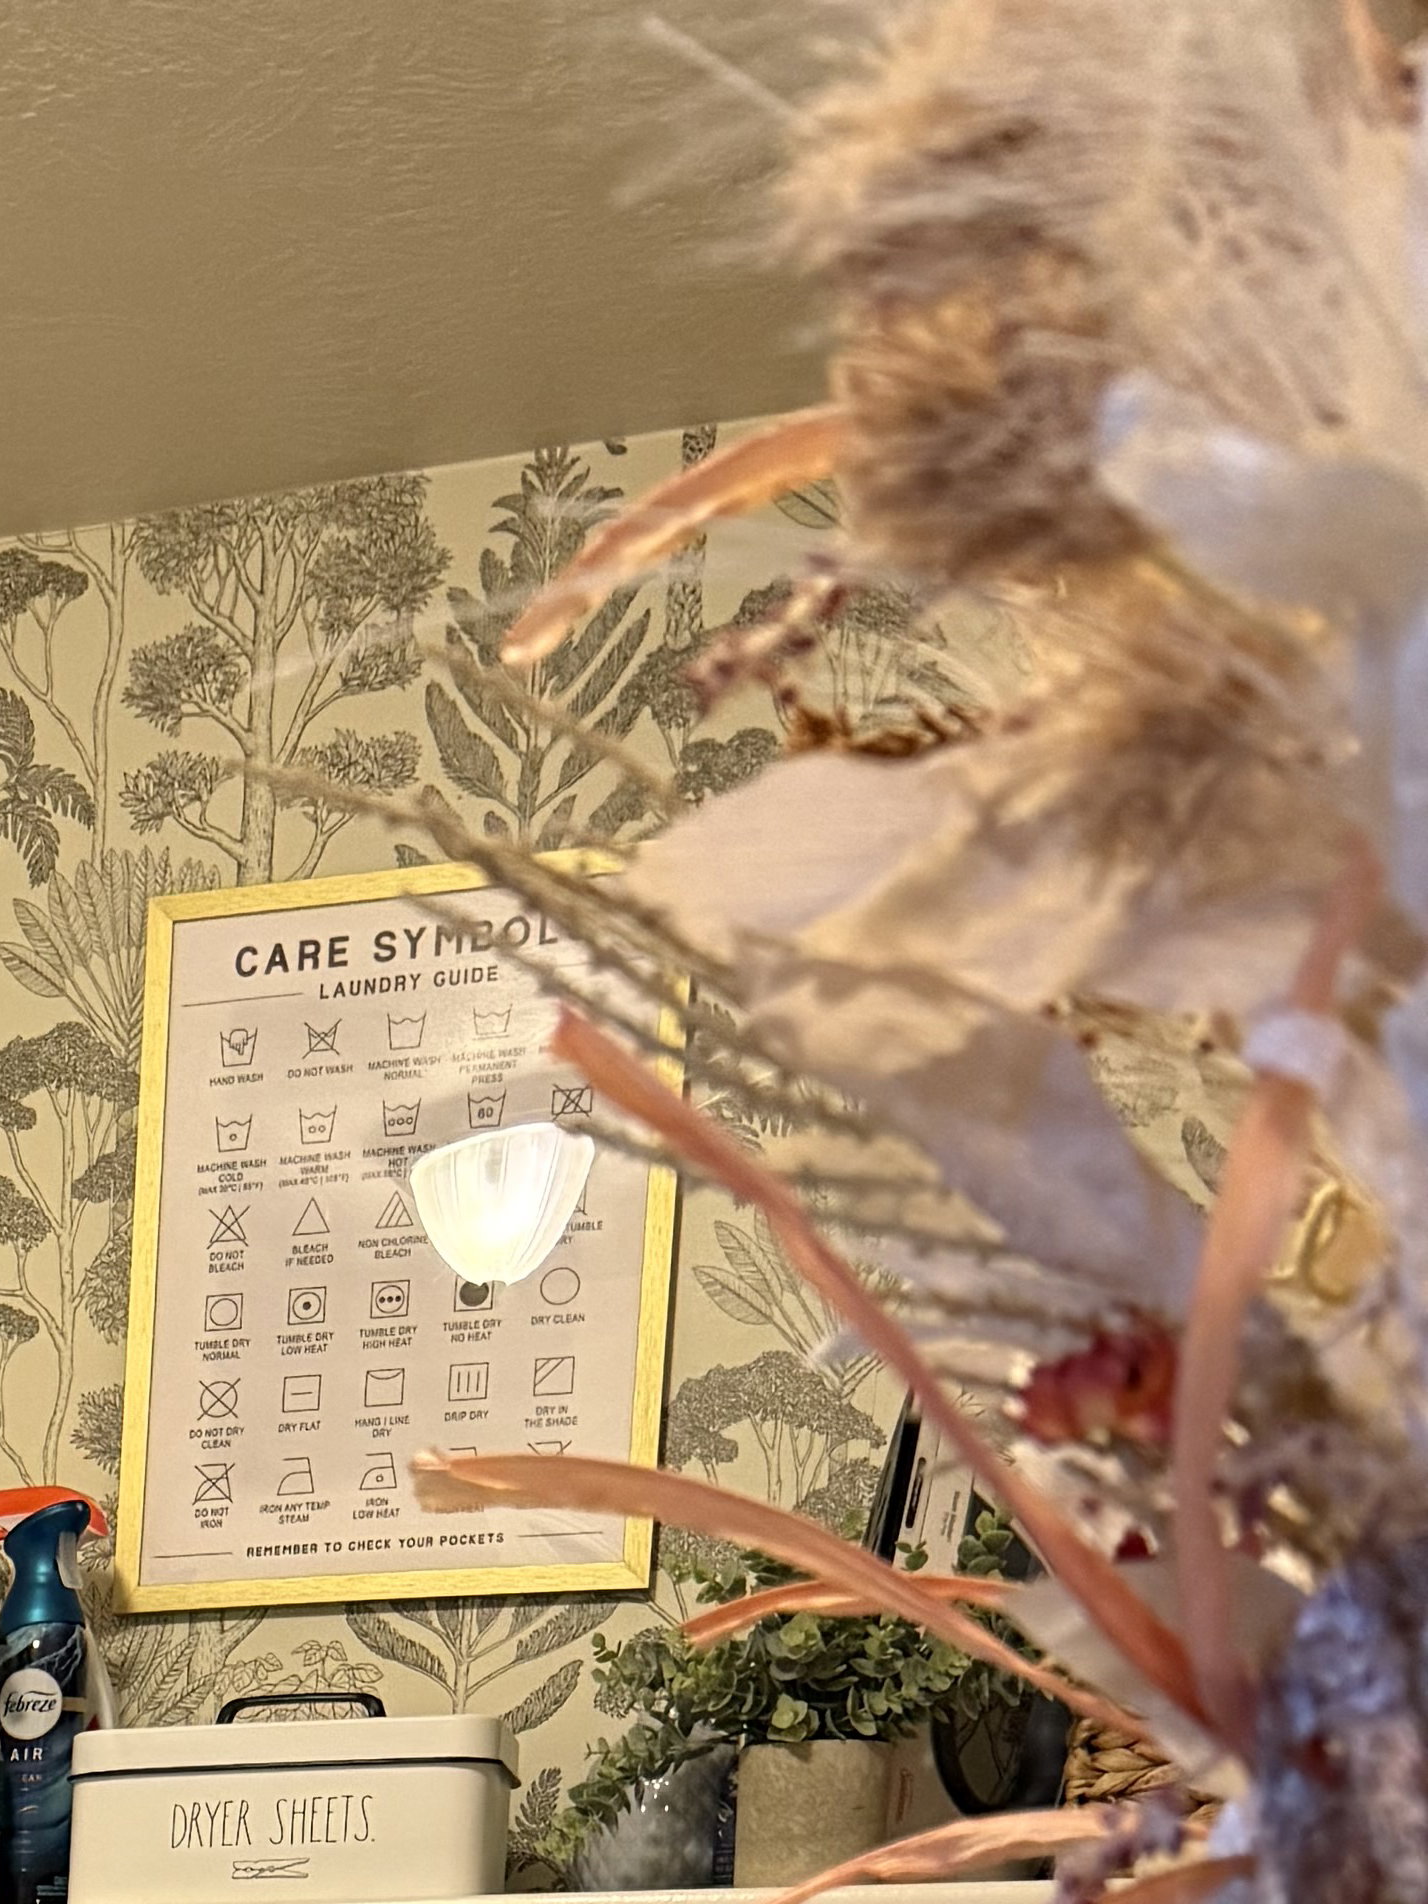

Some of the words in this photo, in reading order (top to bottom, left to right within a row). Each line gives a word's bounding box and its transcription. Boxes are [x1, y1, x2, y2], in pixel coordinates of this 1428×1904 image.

[235, 936, 350, 977] CARE
[373, 914, 559, 963] SYMBOL
[319, 973, 422, 1000] LAUNDRY
[433, 965, 500, 988] GUIDE
[498, 1047, 527, 1058] WASH
[368, 1058, 410, 1070] MACHINE
[412, 1055, 441, 1068] WASH
[458, 1060, 517, 1074] PERMANENT
[288, 1069, 302, 1078] DO
[304, 1068, 324, 1078] NOT
[326, 1065, 354, 1074] WASH
[383, 1069, 423, 1081] NORMAL
[209, 1076, 235, 1087] HAND
[238, 1073, 264, 1084] WASH
[472, 1074, 503, 1085] PRESS
[362, 1146, 406, 1158] MACHINE
[279, 1154, 321, 1166] MACHINE
[324, 1151, 352, 1161] WASH
[388, 1158, 408, 1168] HOT
[197, 1161, 238, 1174] MACHINE
[240, 1159, 267, 1169] WASH
[300, 1164, 329, 1174] WARM
[218, 1172, 244, 1183] COLD
[358, 1238, 380, 1248] NON
[381, 1236, 429, 1247] CHLORINE
[292, 1244, 329, 1254] BLEACH
[374, 1248, 412, 1260] BLEACH
[210, 1252, 221, 1262] DO
[224, 1250, 245, 1260] NOT
[285, 1257, 294, 1267] IF
[296, 1255, 334, 1266] NEEDED
[208, 1262, 244, 1274] BLEACH
[444, 1320, 480, 1332] TUMBLE
[482, 1319, 503, 1330] DRY
[530, 1316, 552, 1326] DRY
[554, 1314, 586, 1324] CLEAN
[277, 1334, 314, 1344] TUMBLE
[315, 1332, 334, 1342] DRY
[360, 1328, 396, 1338] TUMBLE
[398, 1326, 418, 1336] DRY
[451, 1334, 465, 1343] NO
[467, 1332, 492, 1342] HEAT
[194, 1340, 229, 1350] TUMBLE
[230, 1338, 251, 1349] DRY
[281, 1346, 302, 1356] LOW
[304, 1344, 328, 1354] HEAT
[362, 1340, 387, 1350] HIGH
[388, 1338, 413, 1348] HEAT
[202, 1350, 241, 1362] NORMAL
[444, 1412, 468, 1422] DRIP
[470, 1410, 490, 1420] DRY
[536, 1406, 556, 1416] DRY
[558, 1405, 568, 1415] IN
[278, 1423, 298, 1433] DRY
[300, 1421, 321, 1432] FLAT
[354, 1417, 381, 1428] HANG
[390, 1416, 410, 1426] LINE
[524, 1418, 543, 1428] THE
[546, 1416, 578, 1428] SHADE
[189, 1430, 203, 1439] DO
[205, 1428, 224, 1438] NOT
[226, 1426, 245, 1436] DRY
[372, 1428, 392, 1438] DRY
[201, 1440, 232, 1450] CLEAN
[260, 1504, 283, 1514] IRON
[284, 1502, 303, 1512] ANY
[306, 1500, 331, 1510] TEMP
[366, 1498, 389, 1507] IRON
[194, 1508, 206, 1518] DO
[208, 1508, 229, 1517] NOT
[278, 1514, 310, 1524] STEAM
[353, 1510, 374, 1520] LOW
[376, 1508, 400, 1518] HEAT
[200, 1518, 223, 1528] IRON
[246, 1544, 318, 1558] REMEMBER
[325, 1542, 342, 1552] TO
[348, 1538, 392, 1551] CHECK
[398, 1536, 434, 1548] YOUR
[440, 1532, 505, 1546] POCKETS
[2, 1690, 58, 1718] febreze
[10, 1747, 43, 1762] AIR
[171, 1800, 252, 1849] DRYER
